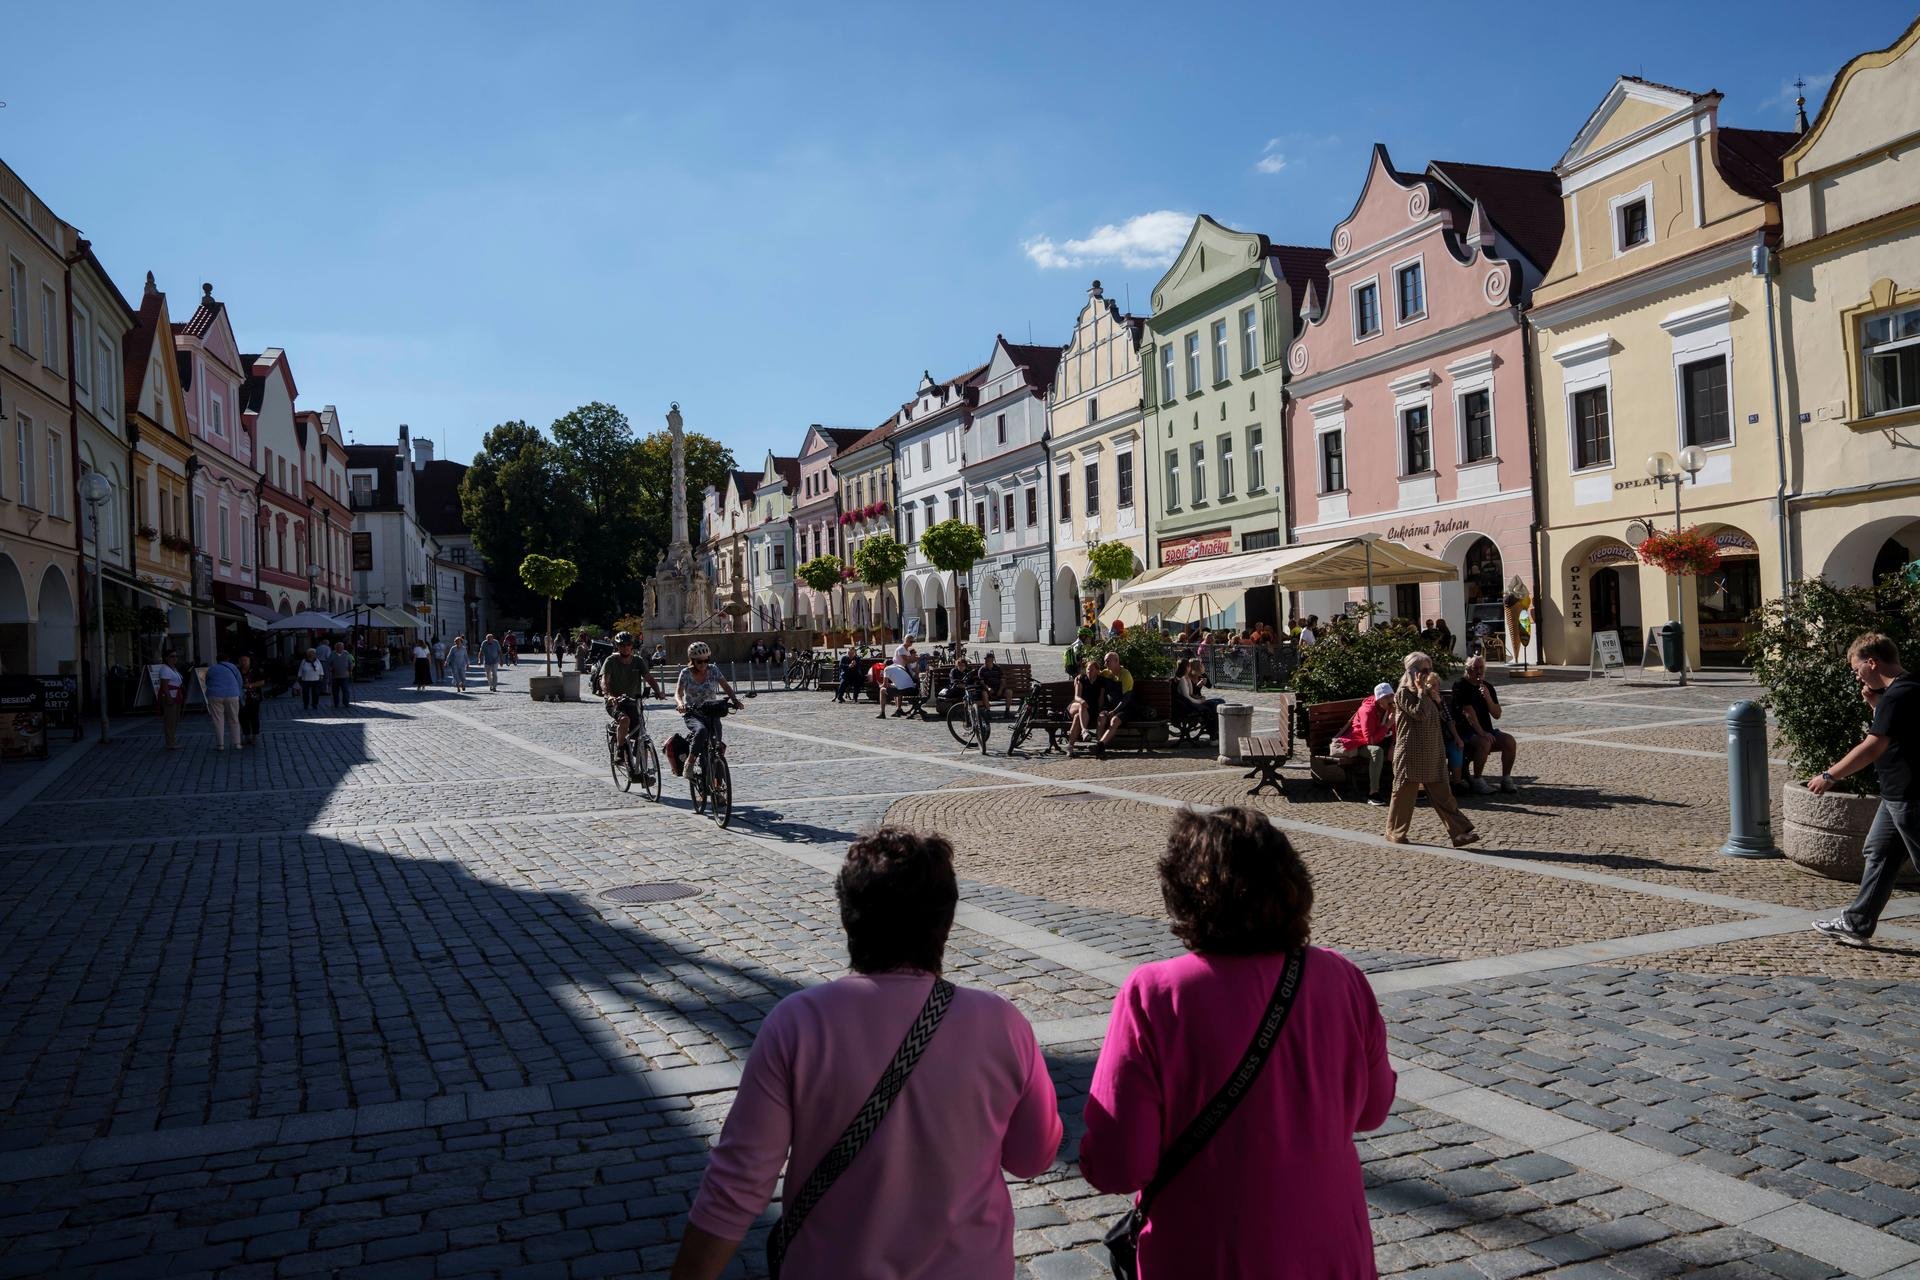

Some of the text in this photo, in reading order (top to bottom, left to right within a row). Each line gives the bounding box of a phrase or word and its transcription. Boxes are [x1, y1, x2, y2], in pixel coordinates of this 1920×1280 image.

[1387, 518, 1470, 541] Cukrárna Jadran
[1166, 545, 1188, 563] sport
[1570, 566, 1583, 627] OPLATKY
[1, 696, 31, 704] BESEDA
[1281, 958, 1300, 998] GUESS
[1258, 1004, 1285, 1049] GUESS
[1227, 1053, 1260, 1098] GUESS
